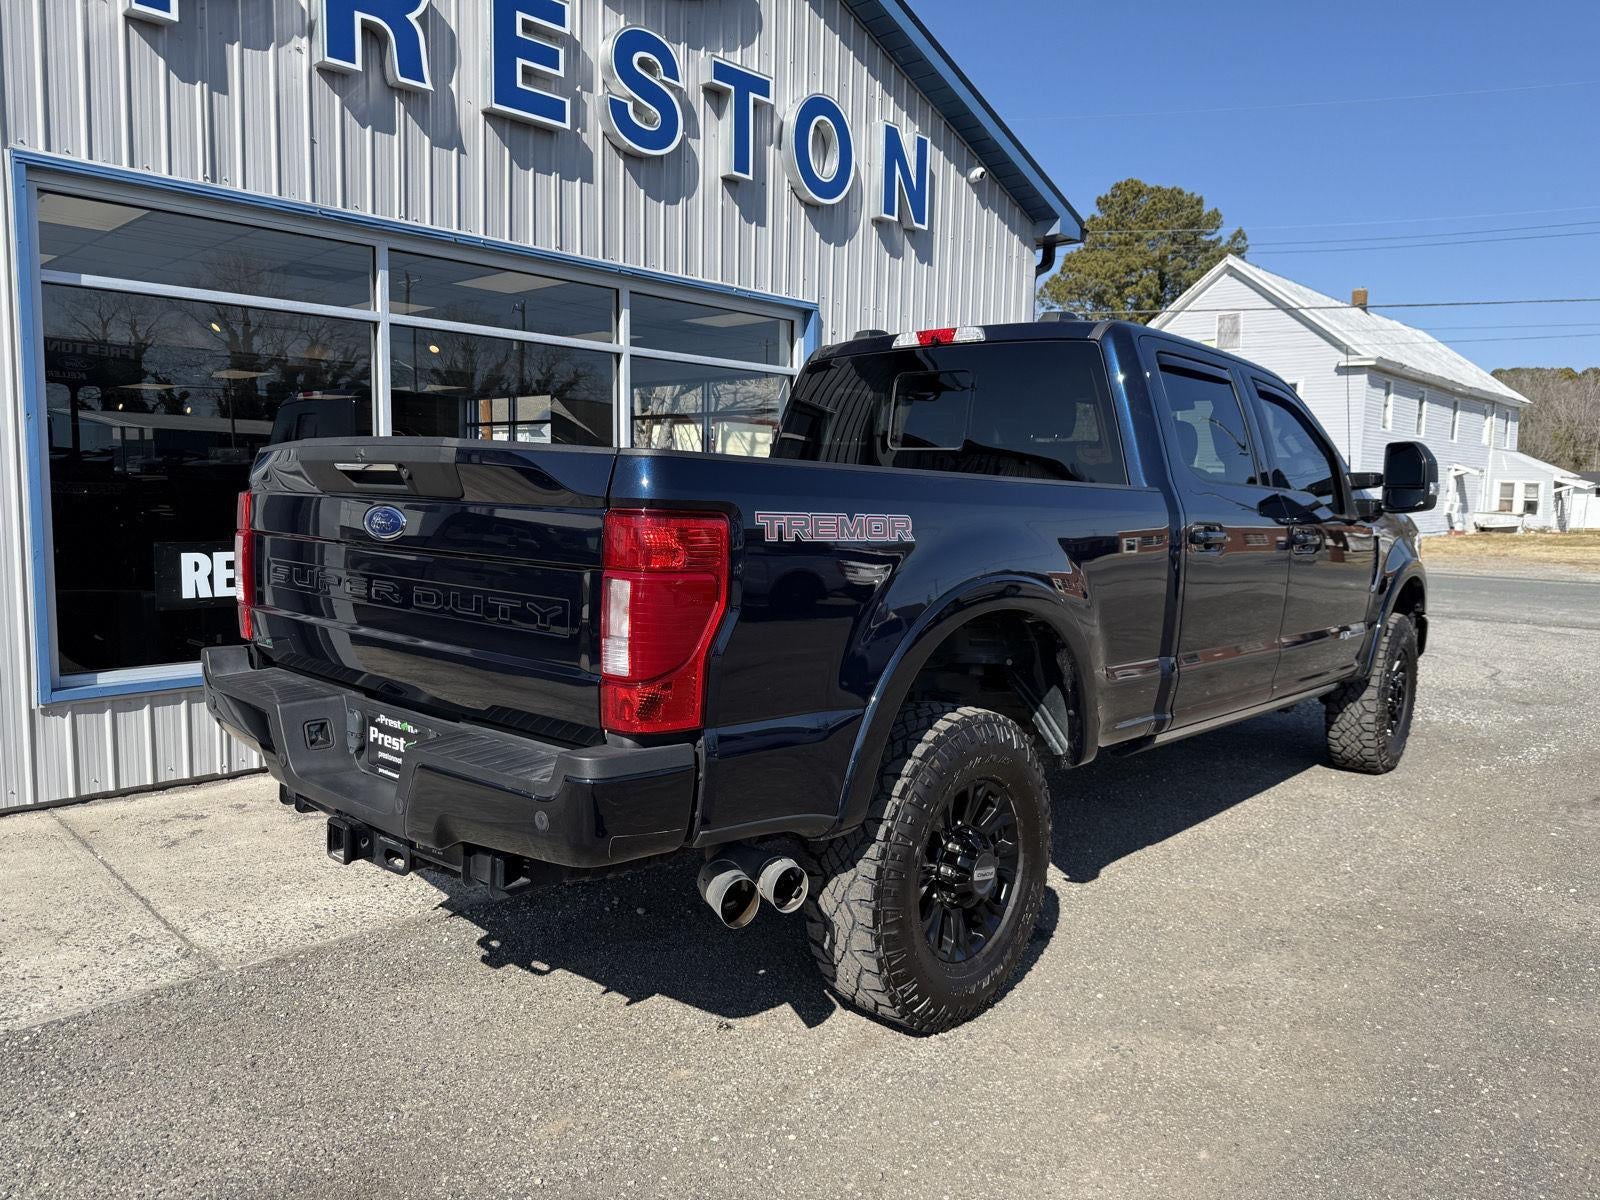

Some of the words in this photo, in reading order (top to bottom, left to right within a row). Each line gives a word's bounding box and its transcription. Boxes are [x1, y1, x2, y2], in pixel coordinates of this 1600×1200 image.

[124, 0, 931, 230] RESTON
[755, 511, 915, 541] TREMOR
[271, 563, 402, 604] SUPER
[413, 586, 563, 628] DUTY
